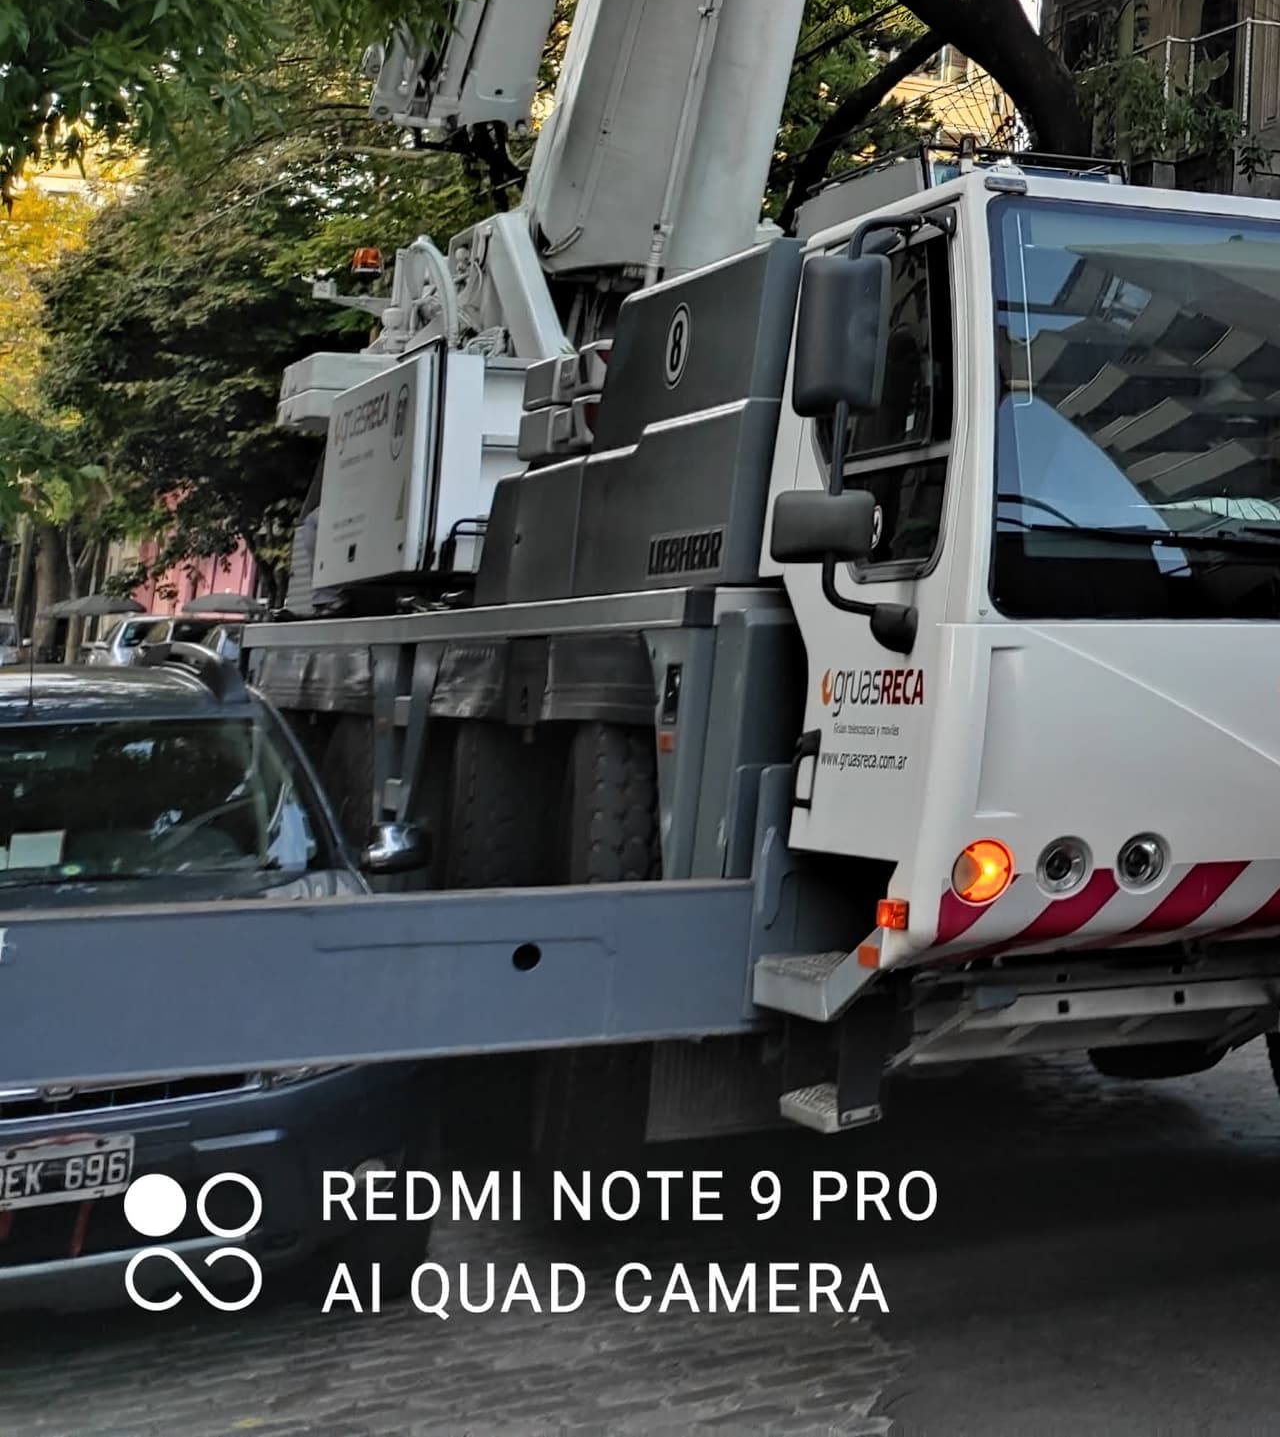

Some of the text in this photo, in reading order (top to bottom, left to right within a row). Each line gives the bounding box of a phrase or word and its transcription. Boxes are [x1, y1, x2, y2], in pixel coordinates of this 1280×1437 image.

[648, 529, 723, 576] LIEBHERR
[832, 668, 924, 717] gruasRECA
[821, 752, 908, 772] www.gruasreca.com.ar
[0, 1162, 44, 1199] EK
